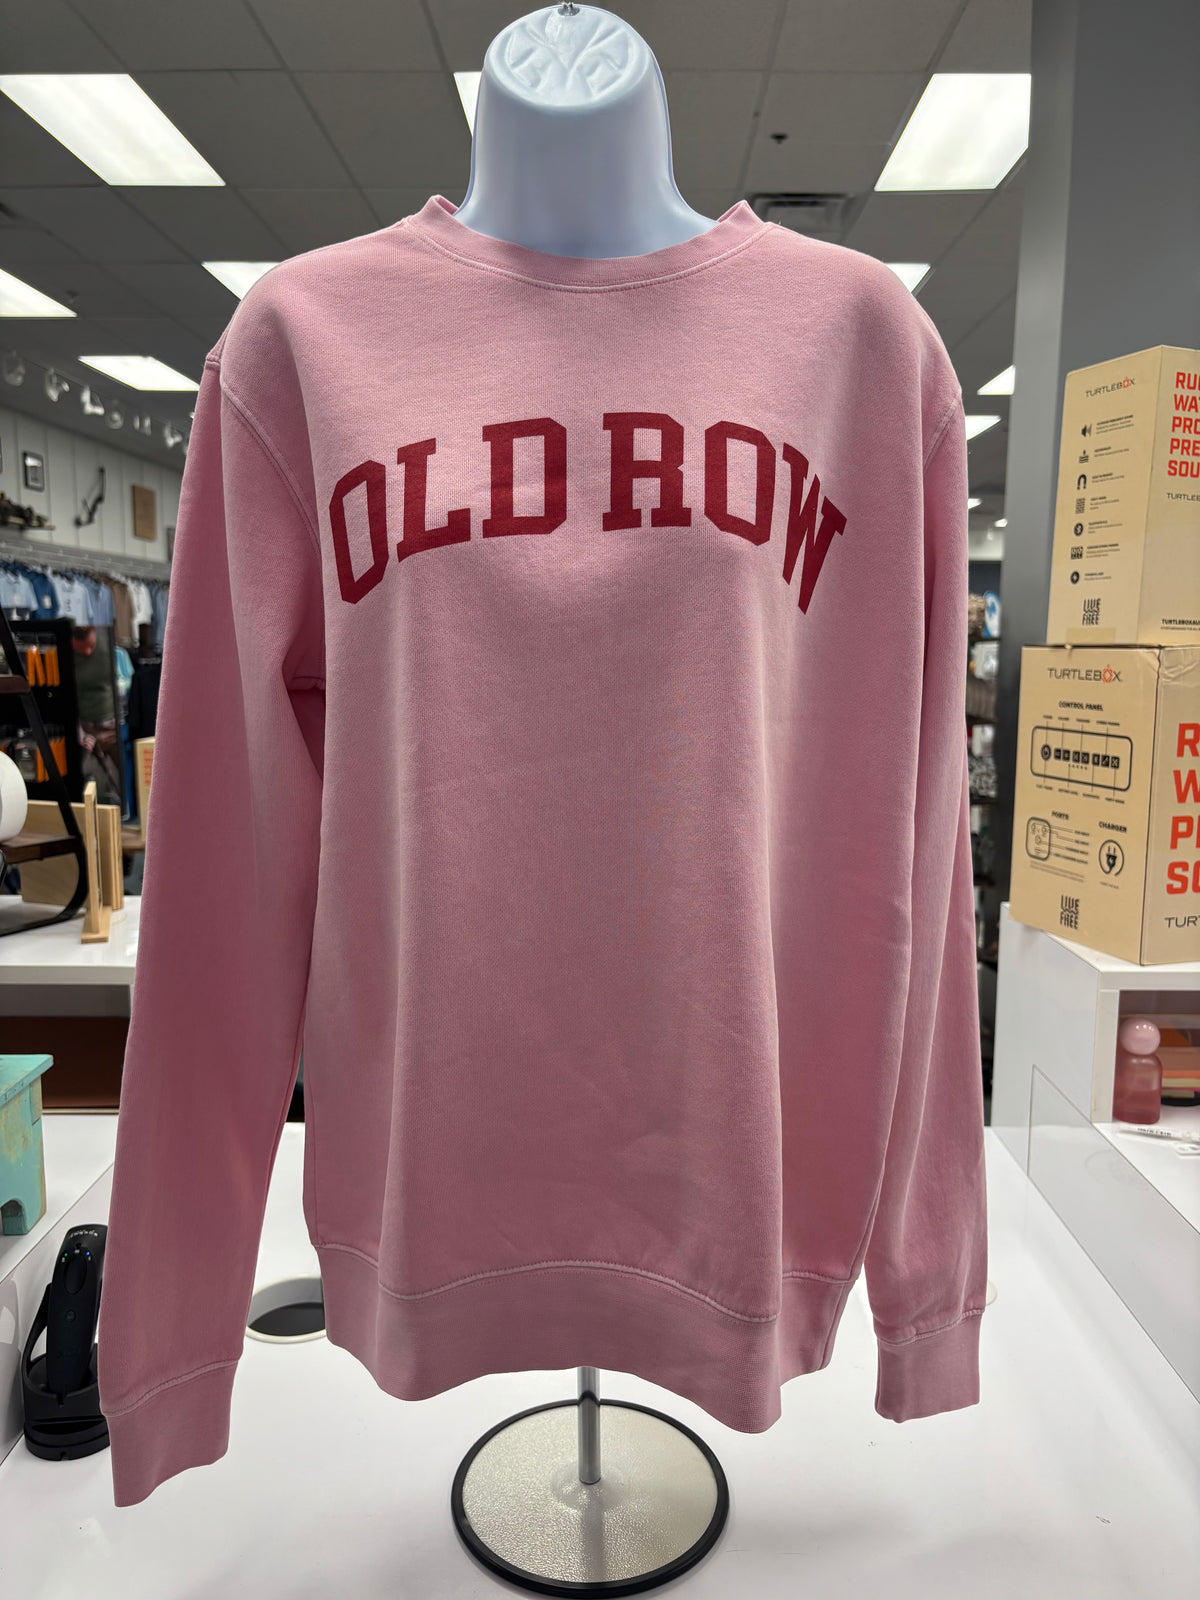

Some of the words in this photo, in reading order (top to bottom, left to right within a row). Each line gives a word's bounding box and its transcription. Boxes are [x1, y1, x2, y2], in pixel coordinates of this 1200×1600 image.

[1085, 376, 1136, 398] TURTLEBOX
[1173, 394, 1200, 413] WA
[328, 416, 568, 605] OLD
[601, 411, 848, 616] ROW
[1047, 664, 1121, 684] TURTLEBOX
[1058, 701, 1084, 710] CONTROL
[1085, 703, 1104, 712] PANEL
[1051, 810, 1069, 821] PORTS
[1098, 821, 1127, 834] CHARGER
